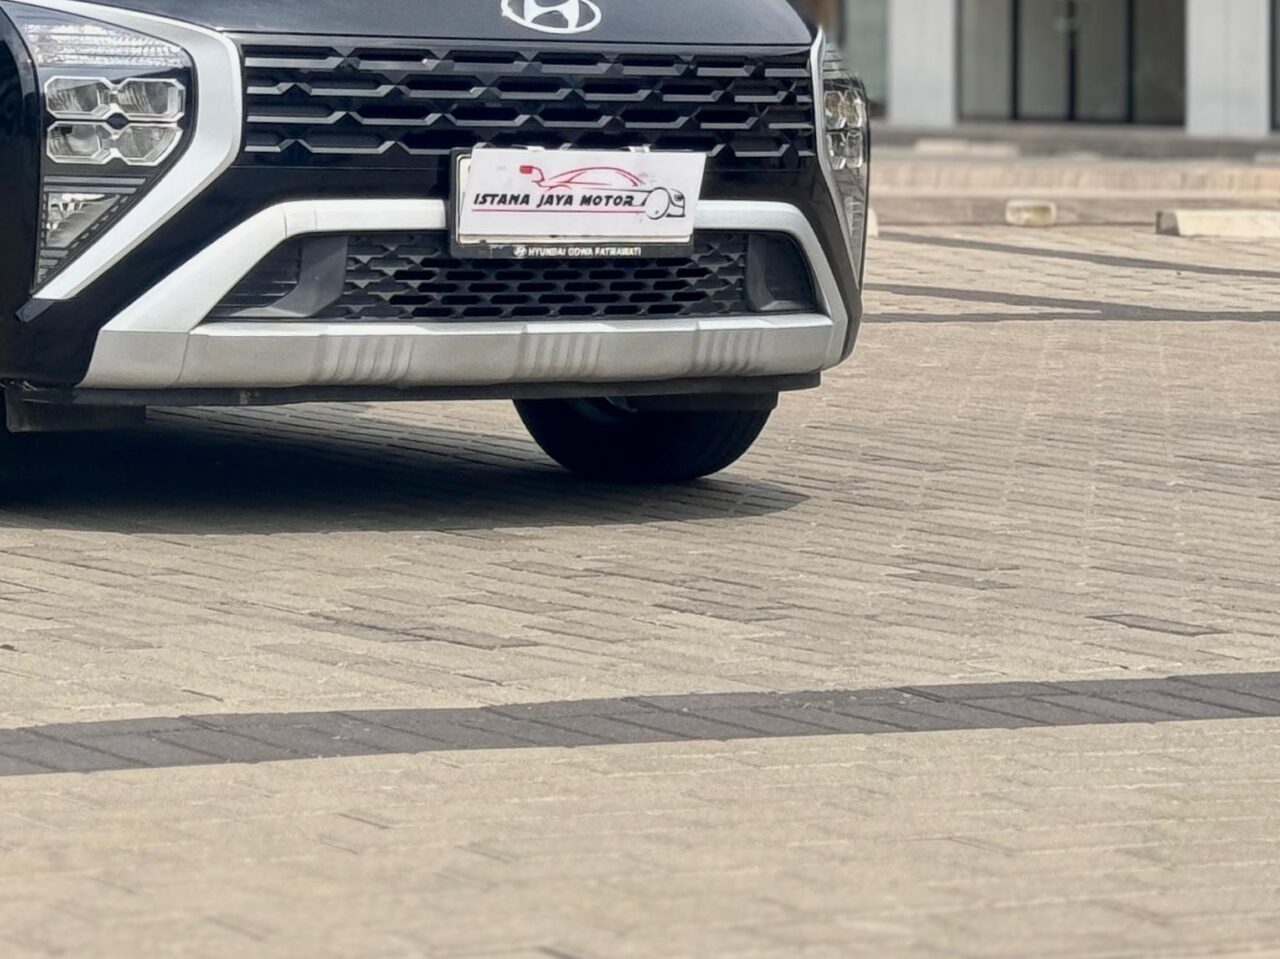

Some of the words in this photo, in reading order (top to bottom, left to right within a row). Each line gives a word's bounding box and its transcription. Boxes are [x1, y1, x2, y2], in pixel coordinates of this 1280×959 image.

[473, 192, 531, 206] ISTANA
[536, 193, 574, 209] JAYA
[579, 194, 635, 207] MOTOR
[527, 246, 567, 257] HYUNDAI
